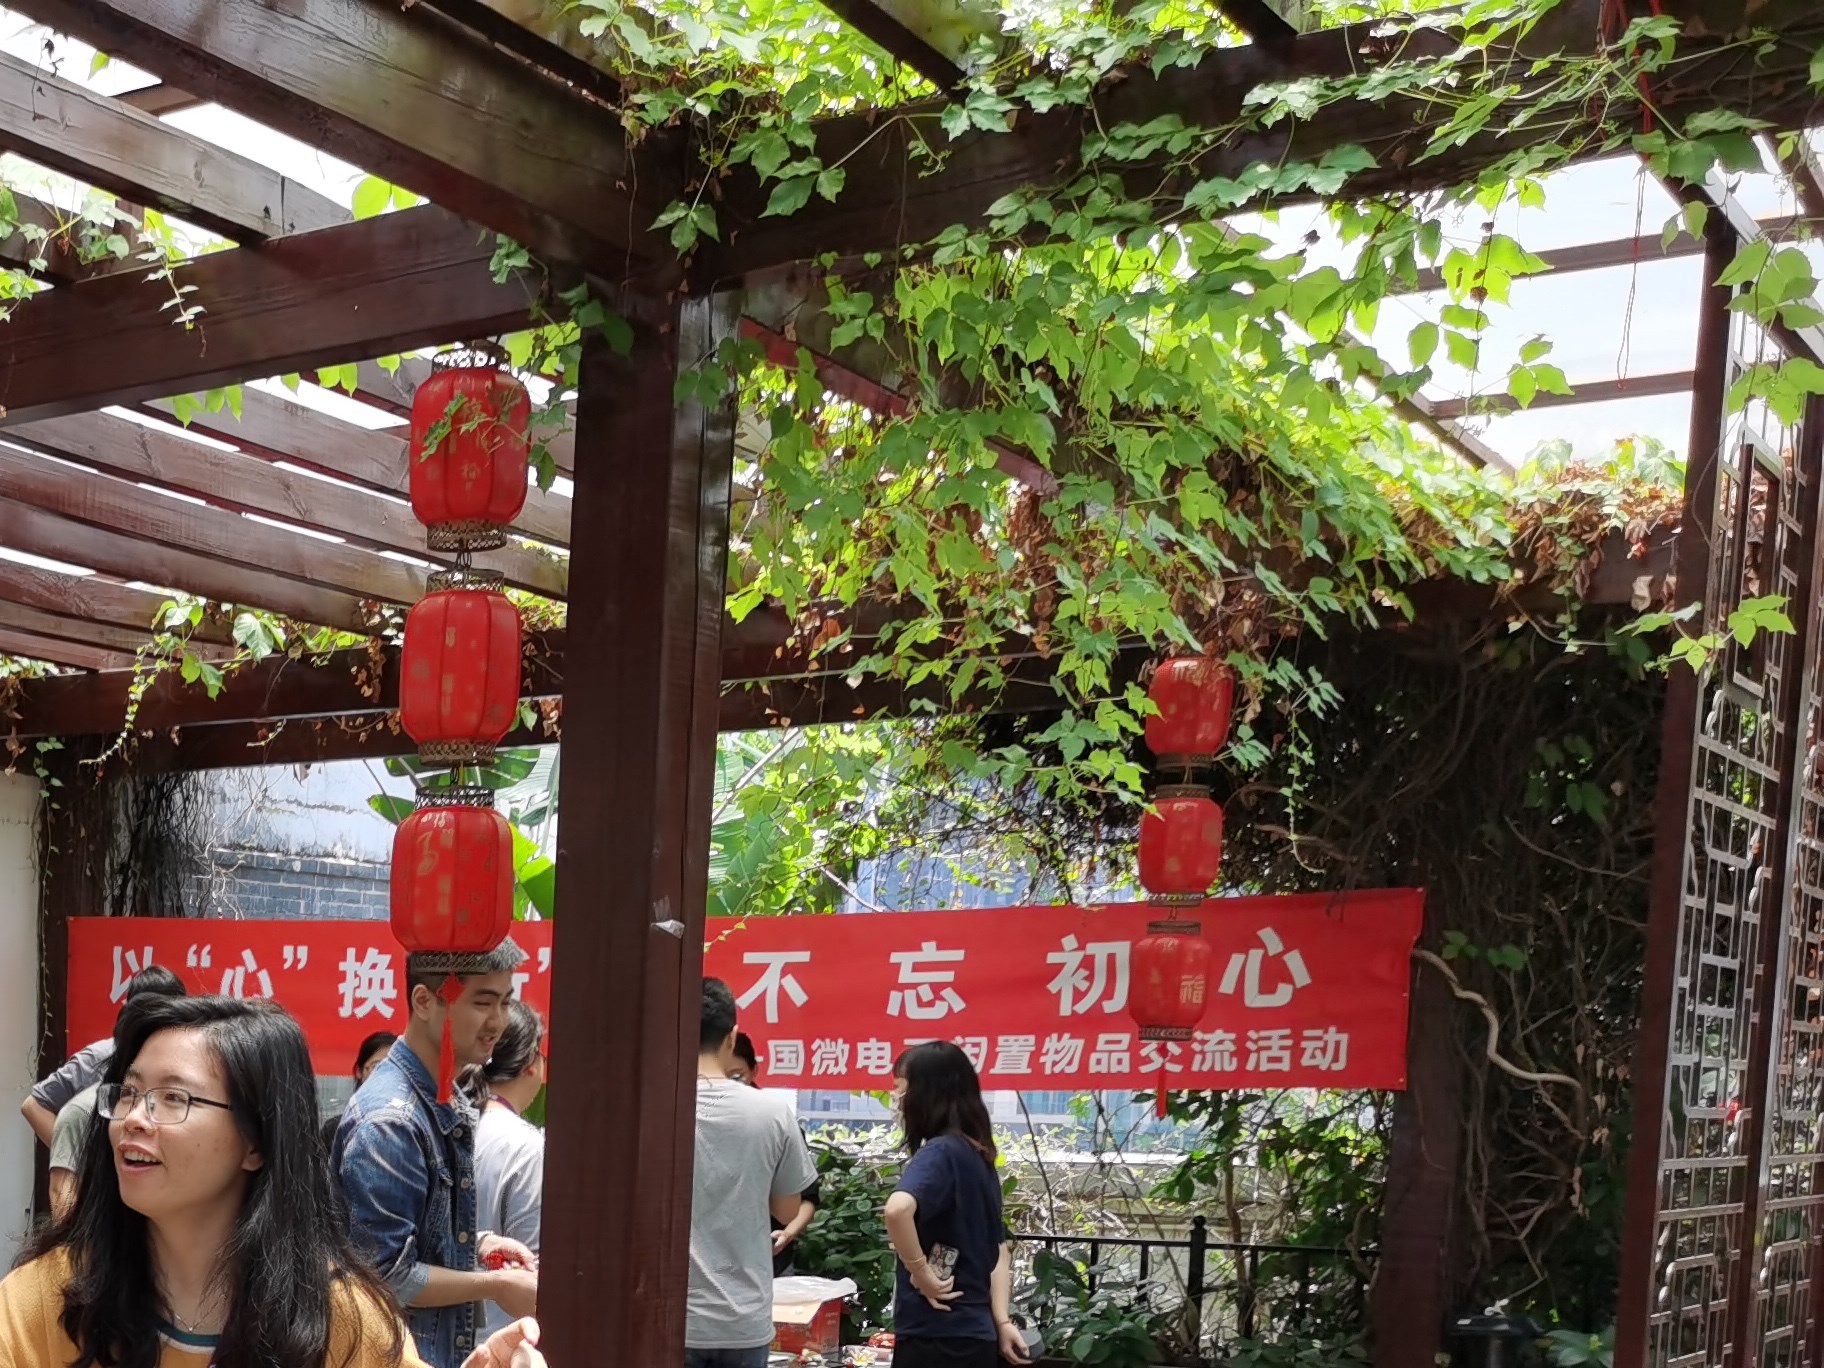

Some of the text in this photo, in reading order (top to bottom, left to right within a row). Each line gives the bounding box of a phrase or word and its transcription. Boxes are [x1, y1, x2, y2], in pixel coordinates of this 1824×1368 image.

[735, 926, 1312, 1024] 不忘初心
[1179, 974, 1205, 1004] 福
[755, 1026, 1349, 1076] 国微电闲置物品交流活动
